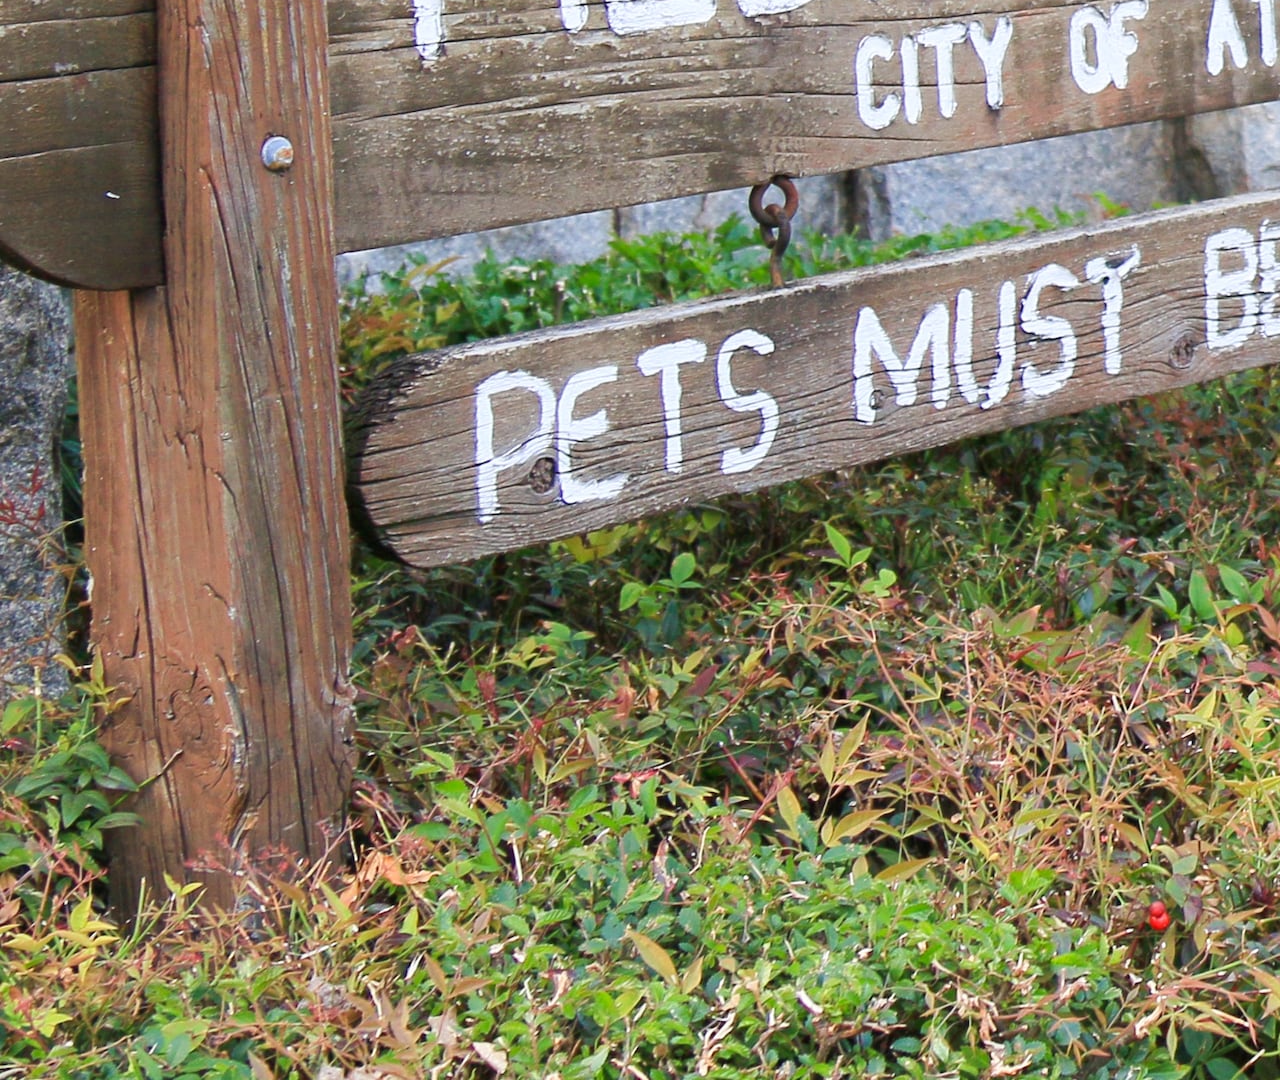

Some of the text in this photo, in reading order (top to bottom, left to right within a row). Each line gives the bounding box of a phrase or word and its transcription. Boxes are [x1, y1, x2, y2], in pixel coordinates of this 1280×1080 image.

[855, 16, 1013, 130] CITY
[474, 327, 780, 524] PETS
[852, 244, 1141, 425] MUST
